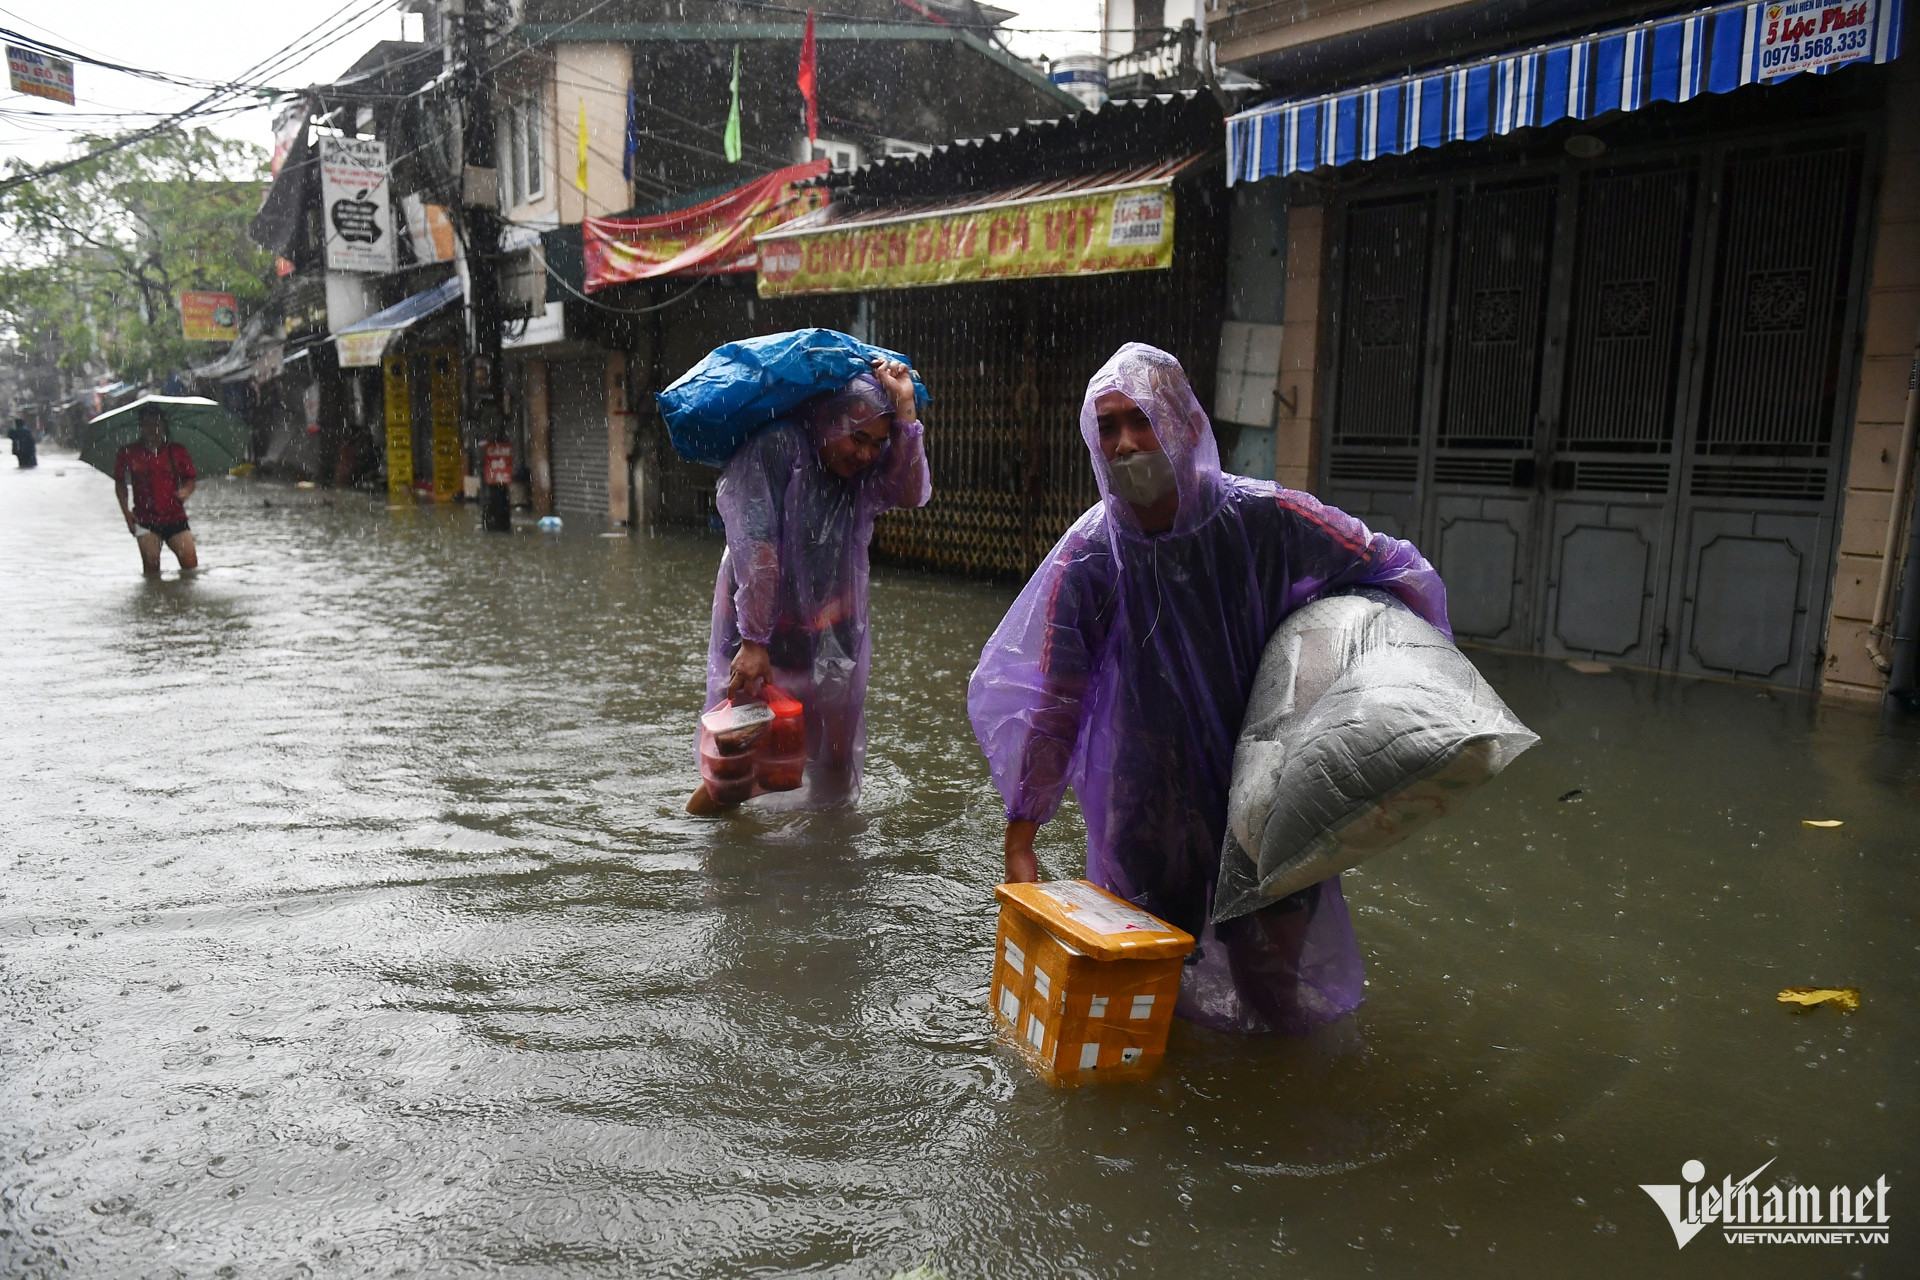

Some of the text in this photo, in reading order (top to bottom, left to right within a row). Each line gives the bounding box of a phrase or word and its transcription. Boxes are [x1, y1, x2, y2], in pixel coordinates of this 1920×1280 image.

[1766, 1, 1868, 45] 5 Lộc Phát
[9, 47, 44, 66] MUA
[1762, 28, 1868, 68] 0979.568.333
[1045, 206, 1099, 260] VỊT
